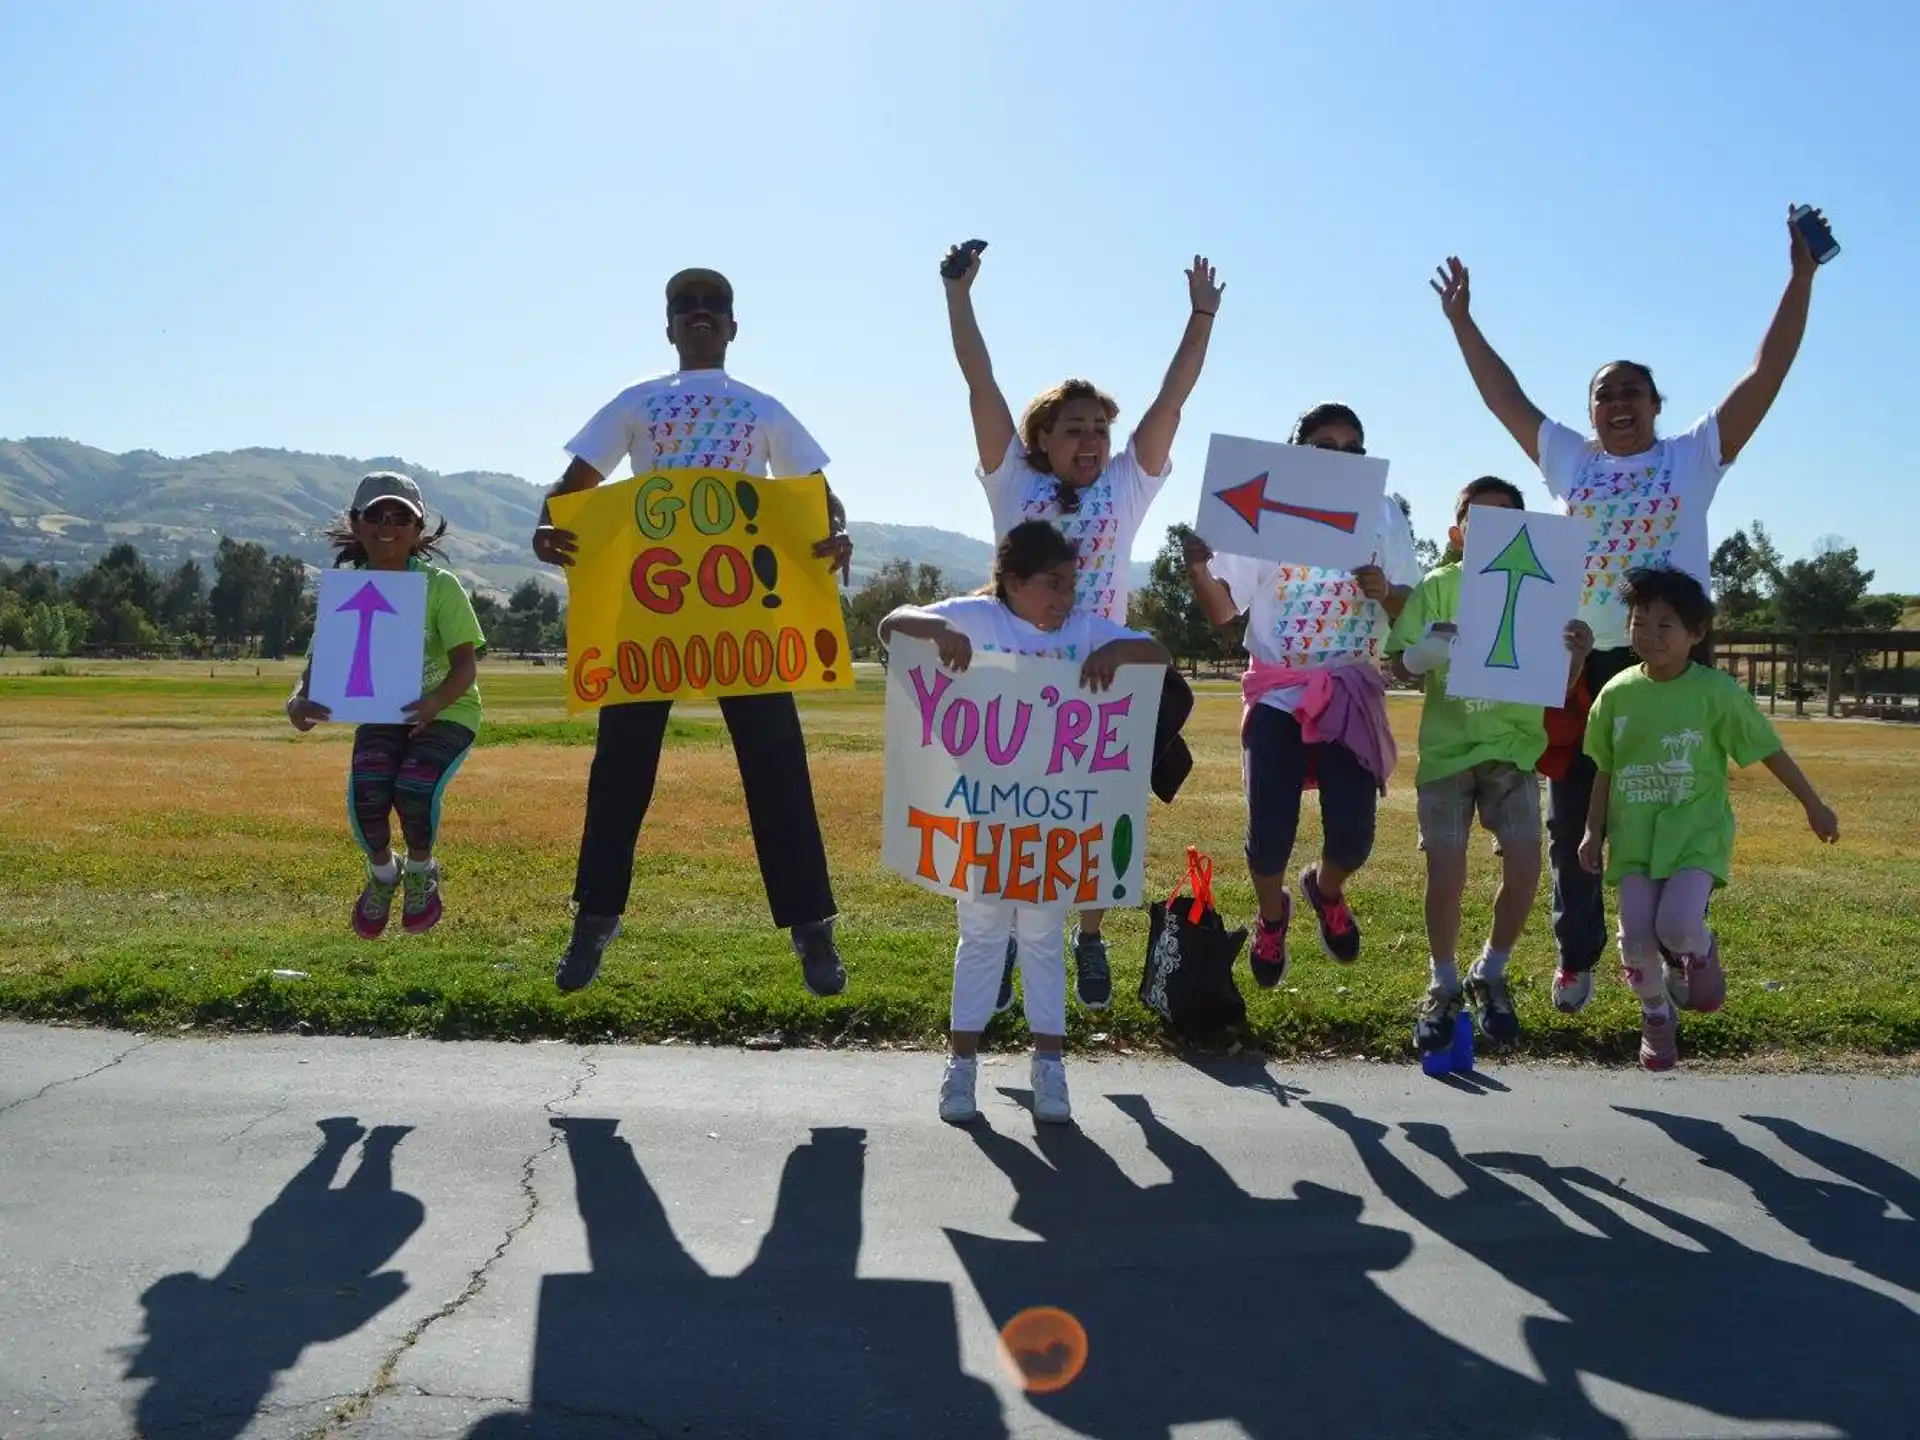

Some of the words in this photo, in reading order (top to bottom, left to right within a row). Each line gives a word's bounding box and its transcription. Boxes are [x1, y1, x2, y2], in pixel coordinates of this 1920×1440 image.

[635, 476, 759, 540] GO!
[630, 544, 778, 614] GO!
[908, 665, 1133, 775] YOU'RE
[944, 774, 1098, 822] ALMOST
[908, 805, 1133, 904] THERE!
